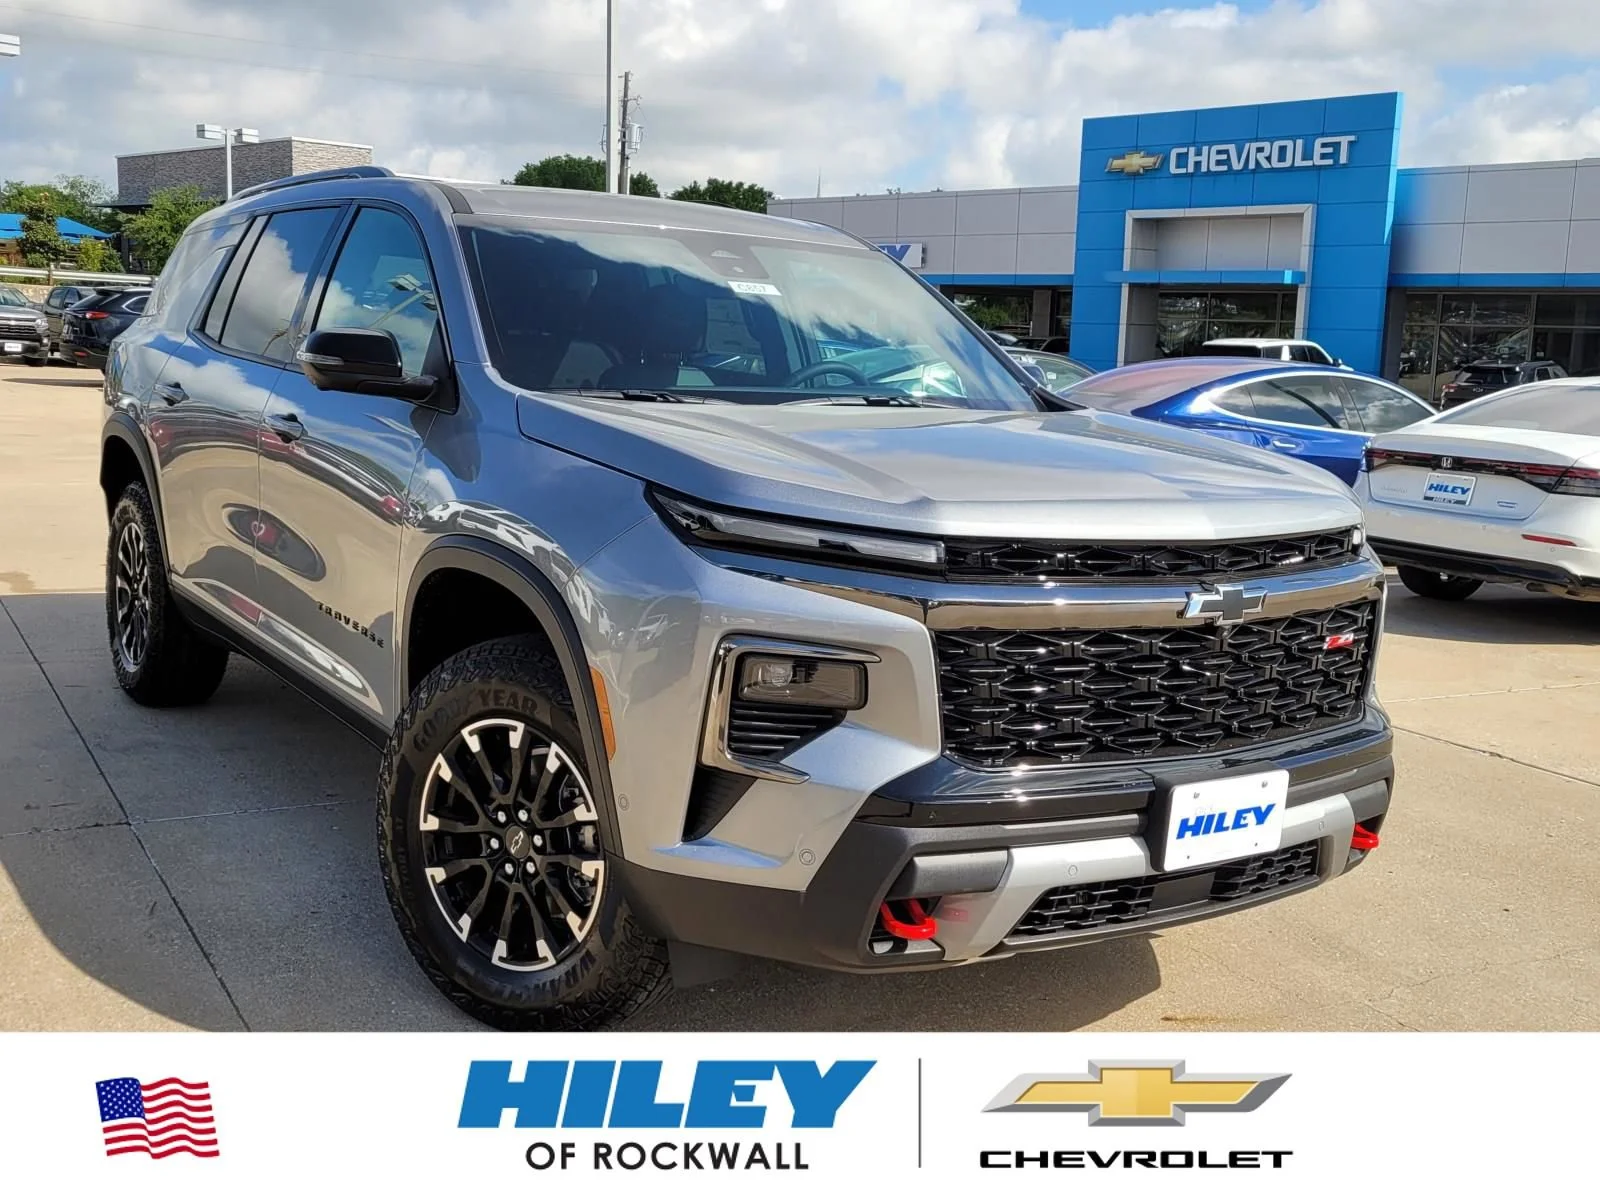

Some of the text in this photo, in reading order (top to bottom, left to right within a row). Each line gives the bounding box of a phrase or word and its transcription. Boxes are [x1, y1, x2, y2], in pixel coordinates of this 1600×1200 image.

[1169, 135, 1357, 175] CHEVROLET
[1428, 482, 1471, 495] HILEY
[317, 601, 385, 649] TRAVERSE
[1175, 803, 1276, 840] HILEY
